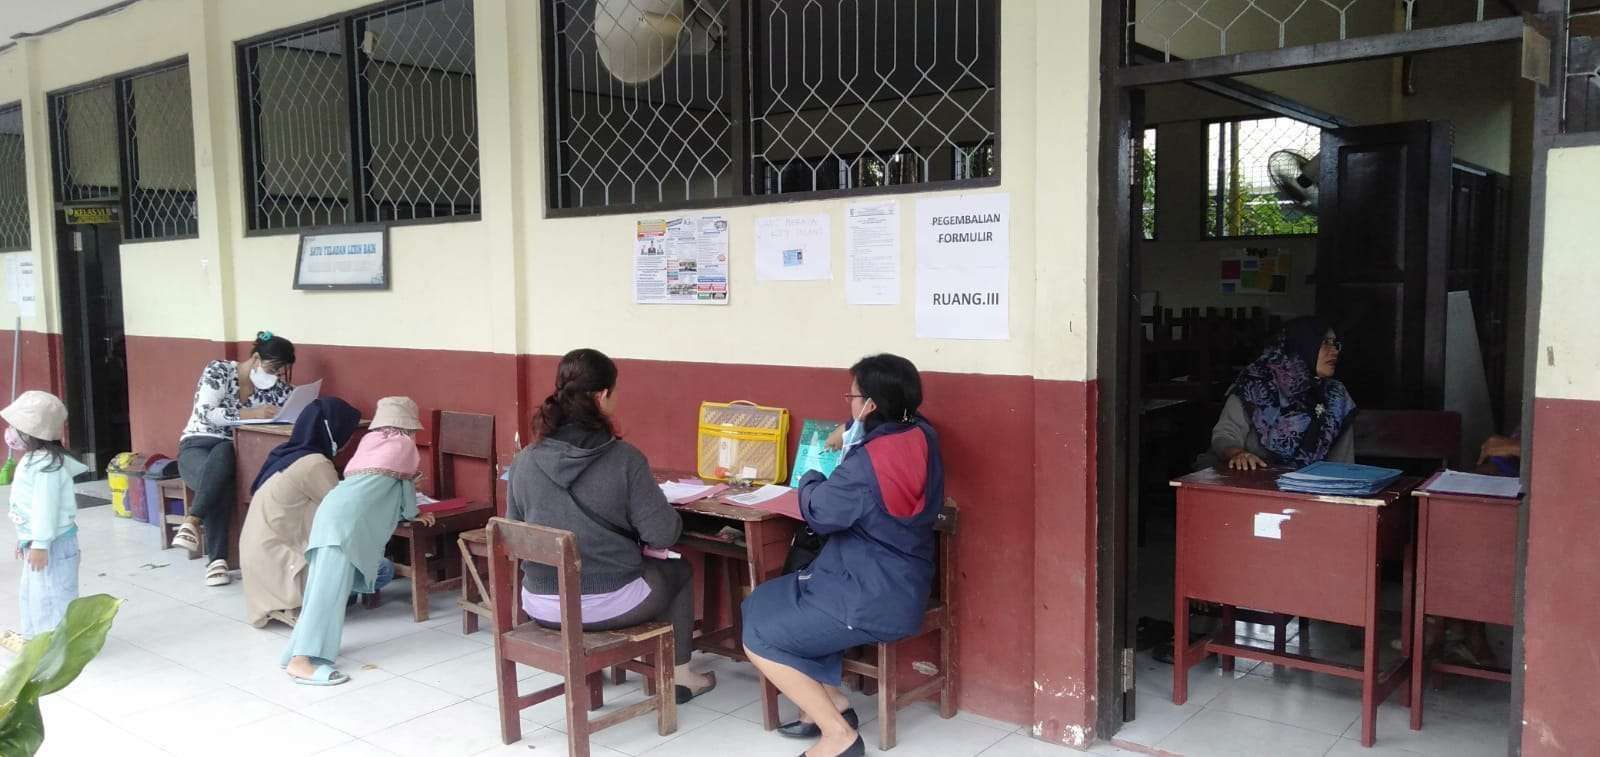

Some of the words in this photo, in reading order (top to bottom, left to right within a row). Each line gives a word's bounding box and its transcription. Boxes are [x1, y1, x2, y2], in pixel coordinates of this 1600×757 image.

[932, 213, 1001, 226] PEGEMBALIAN
[938, 231, 993, 244] FORMULIR
[932, 292, 999, 306] RUANG.III
